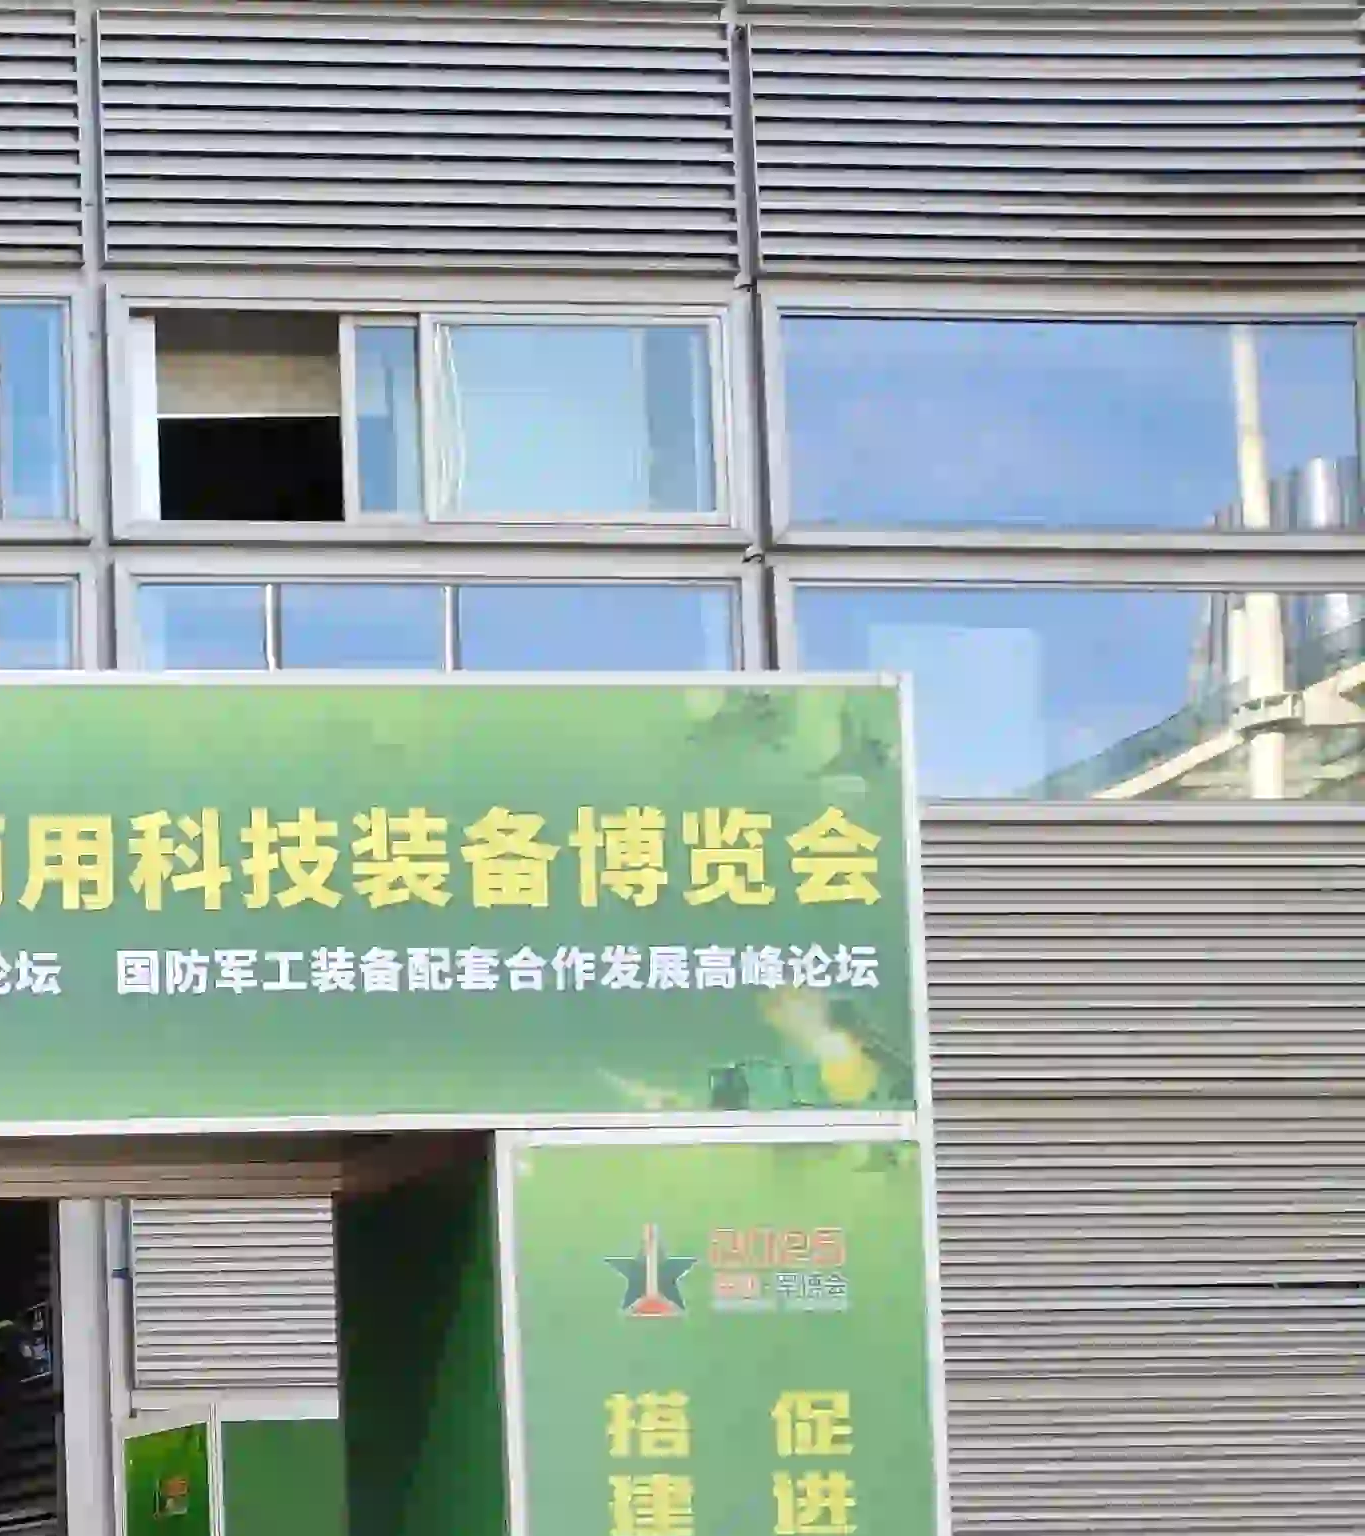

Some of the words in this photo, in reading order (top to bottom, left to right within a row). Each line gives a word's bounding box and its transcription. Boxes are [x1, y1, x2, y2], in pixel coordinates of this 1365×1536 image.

[115, 942, 881, 996] 国防军工装备配套合作发展高峰论坛
